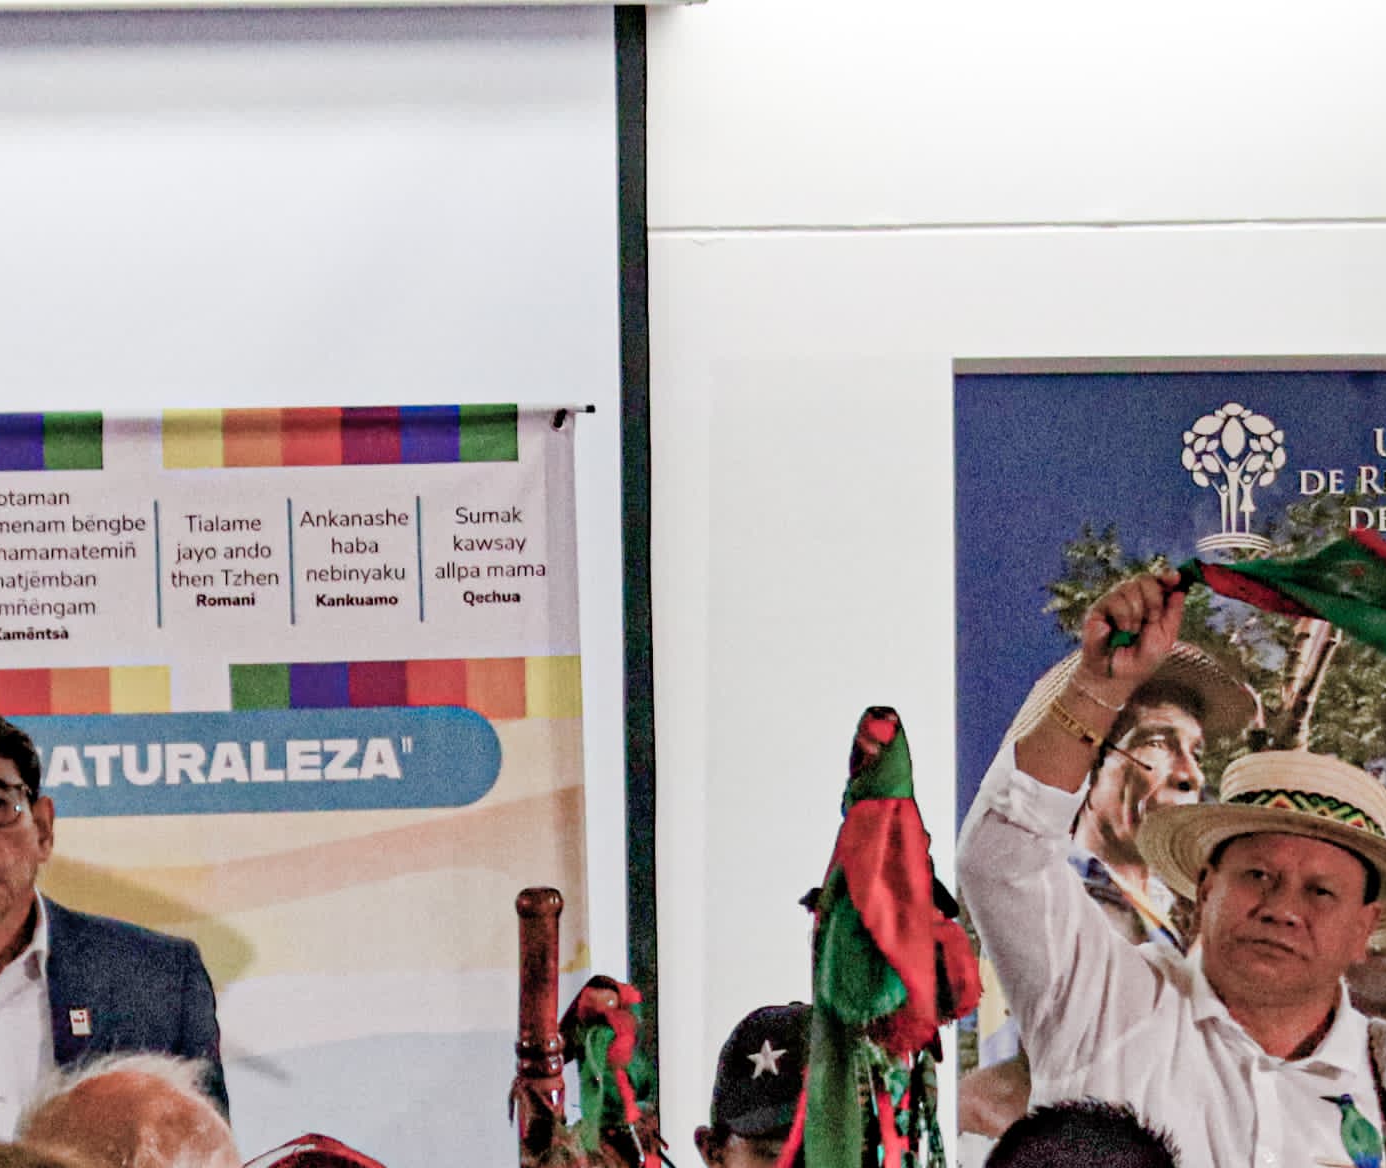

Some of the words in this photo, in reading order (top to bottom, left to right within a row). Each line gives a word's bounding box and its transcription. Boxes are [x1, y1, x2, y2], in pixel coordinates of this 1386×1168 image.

[1300, 470, 1345, 494] DE
[185, 515, 261, 533] Tialame
[300, 508, 408, 527] Ankanashe
[456, 506, 522, 524] Sumak
[176, 543, 216, 564] jayo
[224, 542, 271, 559] ando
[332, 537, 378, 554] haba
[453, 535, 526, 553] kawsay
[171, 571, 213, 588] then
[221, 569, 279, 586] Tzhen
[307, 564, 405, 584] nebinyaku
[435, 562, 480, 582] allpa
[486, 563, 546, 578] mama
[197, 592, 255, 607] Romani
[315, 593, 399, 608] Kankuamo
[463, 590, 521, 607] Qechua
[37, 736, 412, 787] ATURALEZA"
